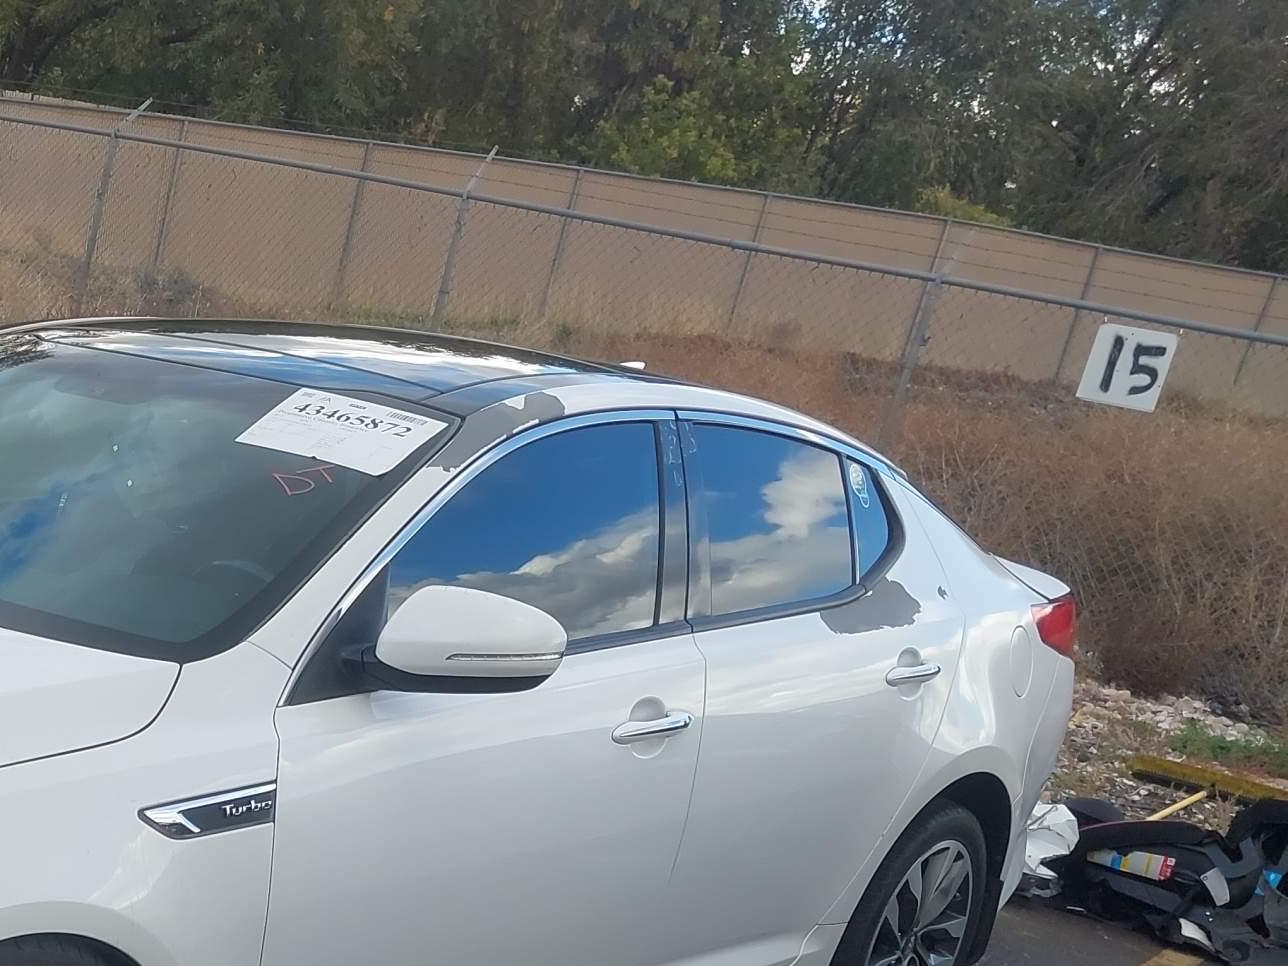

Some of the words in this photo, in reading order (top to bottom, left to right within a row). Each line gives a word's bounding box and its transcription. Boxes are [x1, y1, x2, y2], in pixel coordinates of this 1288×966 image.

[1098, 335, 1167, 396] 15
[293, 403, 413, 438] 43465872
[221, 800, 273, 817] Turbo
